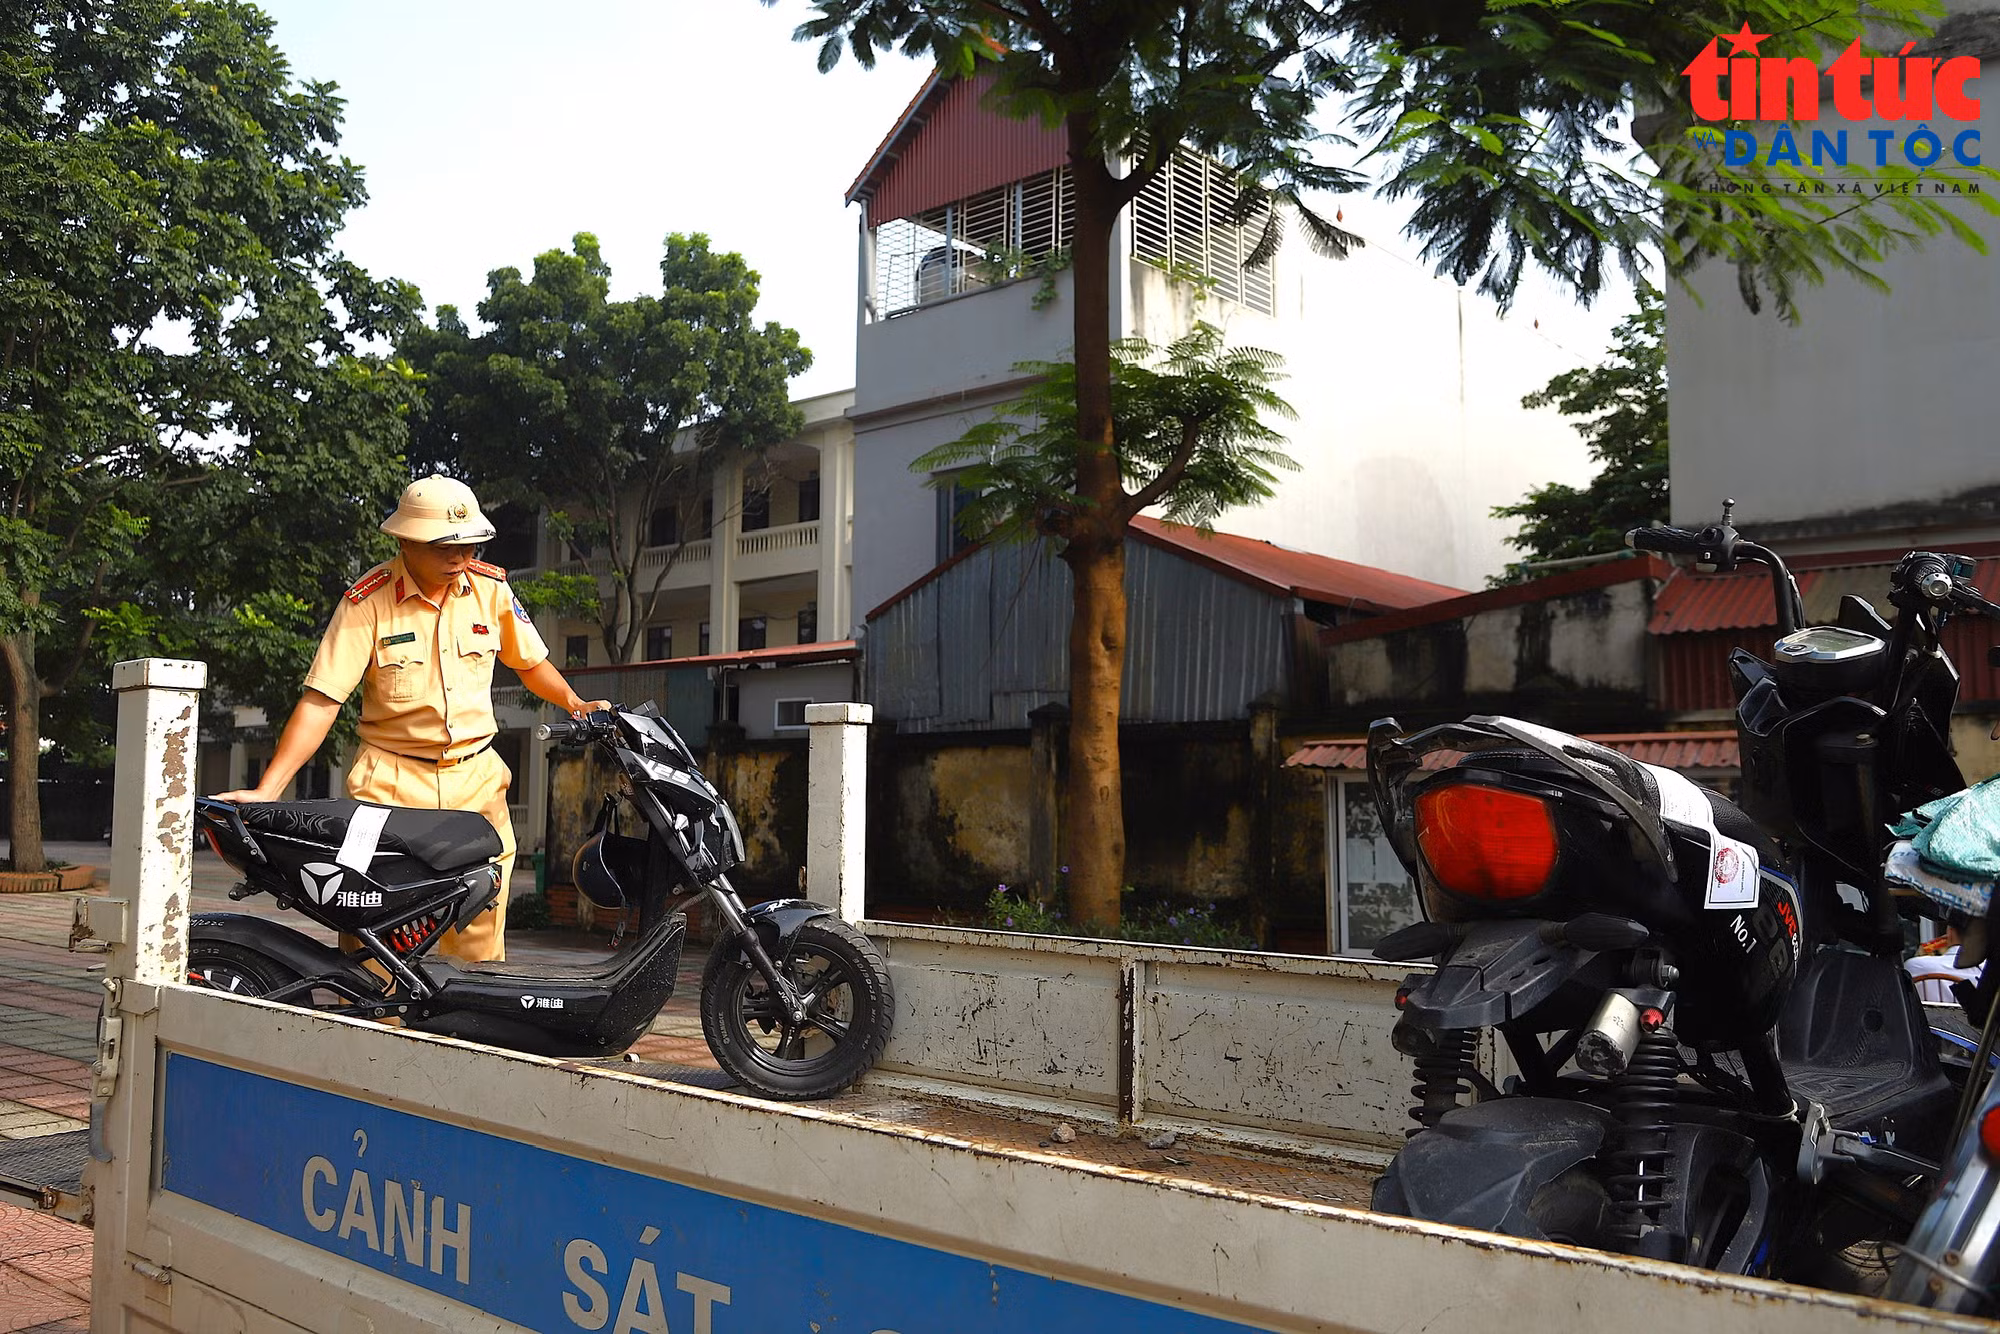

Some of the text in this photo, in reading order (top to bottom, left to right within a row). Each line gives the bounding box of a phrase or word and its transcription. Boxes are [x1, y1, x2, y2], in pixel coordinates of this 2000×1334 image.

[646, 759, 692, 785] 125
[335, 890, 383, 908] 雅迪
[535, 997, 564, 1009] 雅迪
[302, 1128, 731, 1334] CẢNH SÁT
